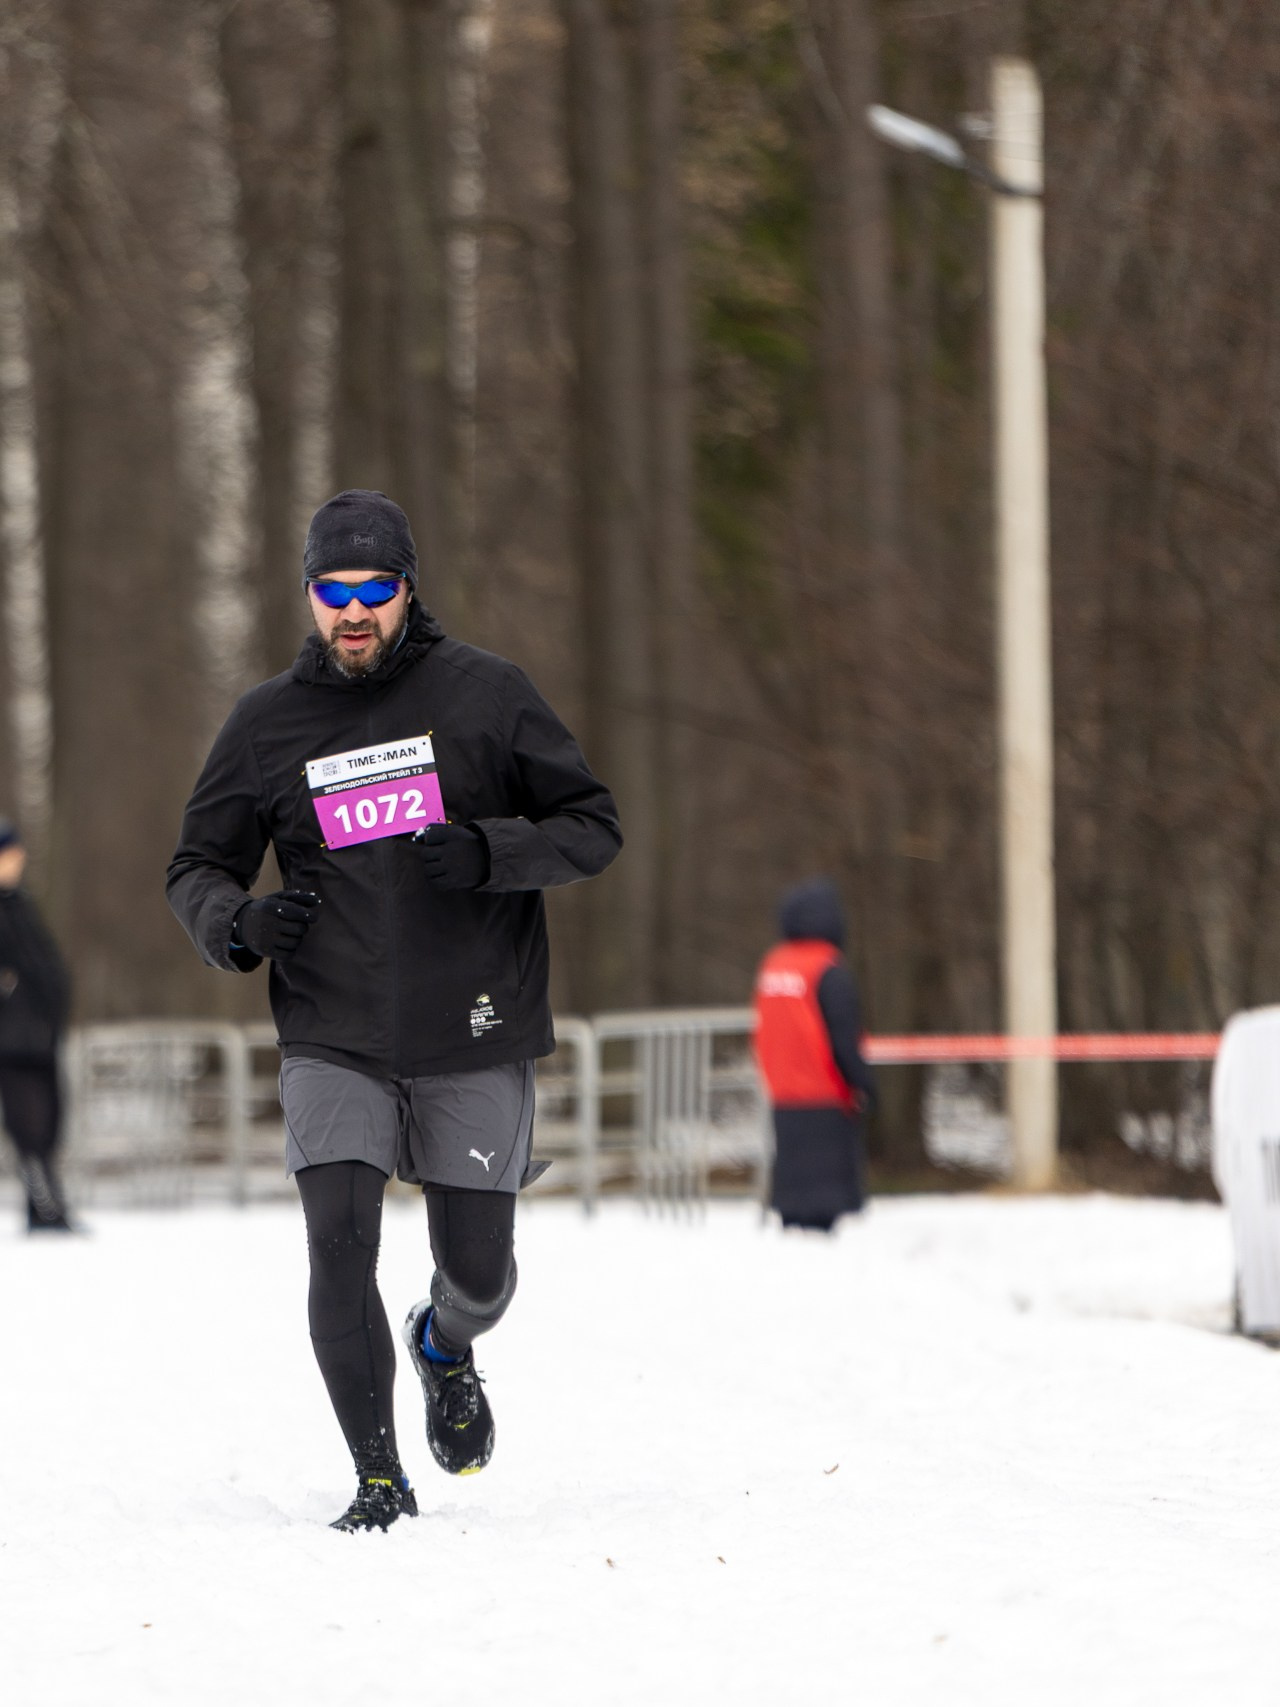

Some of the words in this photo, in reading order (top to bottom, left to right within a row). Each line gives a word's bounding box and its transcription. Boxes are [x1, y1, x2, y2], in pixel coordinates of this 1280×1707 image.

[353, 535, 375, 546] Buff
[324, 773, 388, 795] ЗЕЛЕНОДОЛЬСКИЙ
[388, 768, 411, 782] ТРЕЙЛ
[333, 789, 427, 834] 1072
